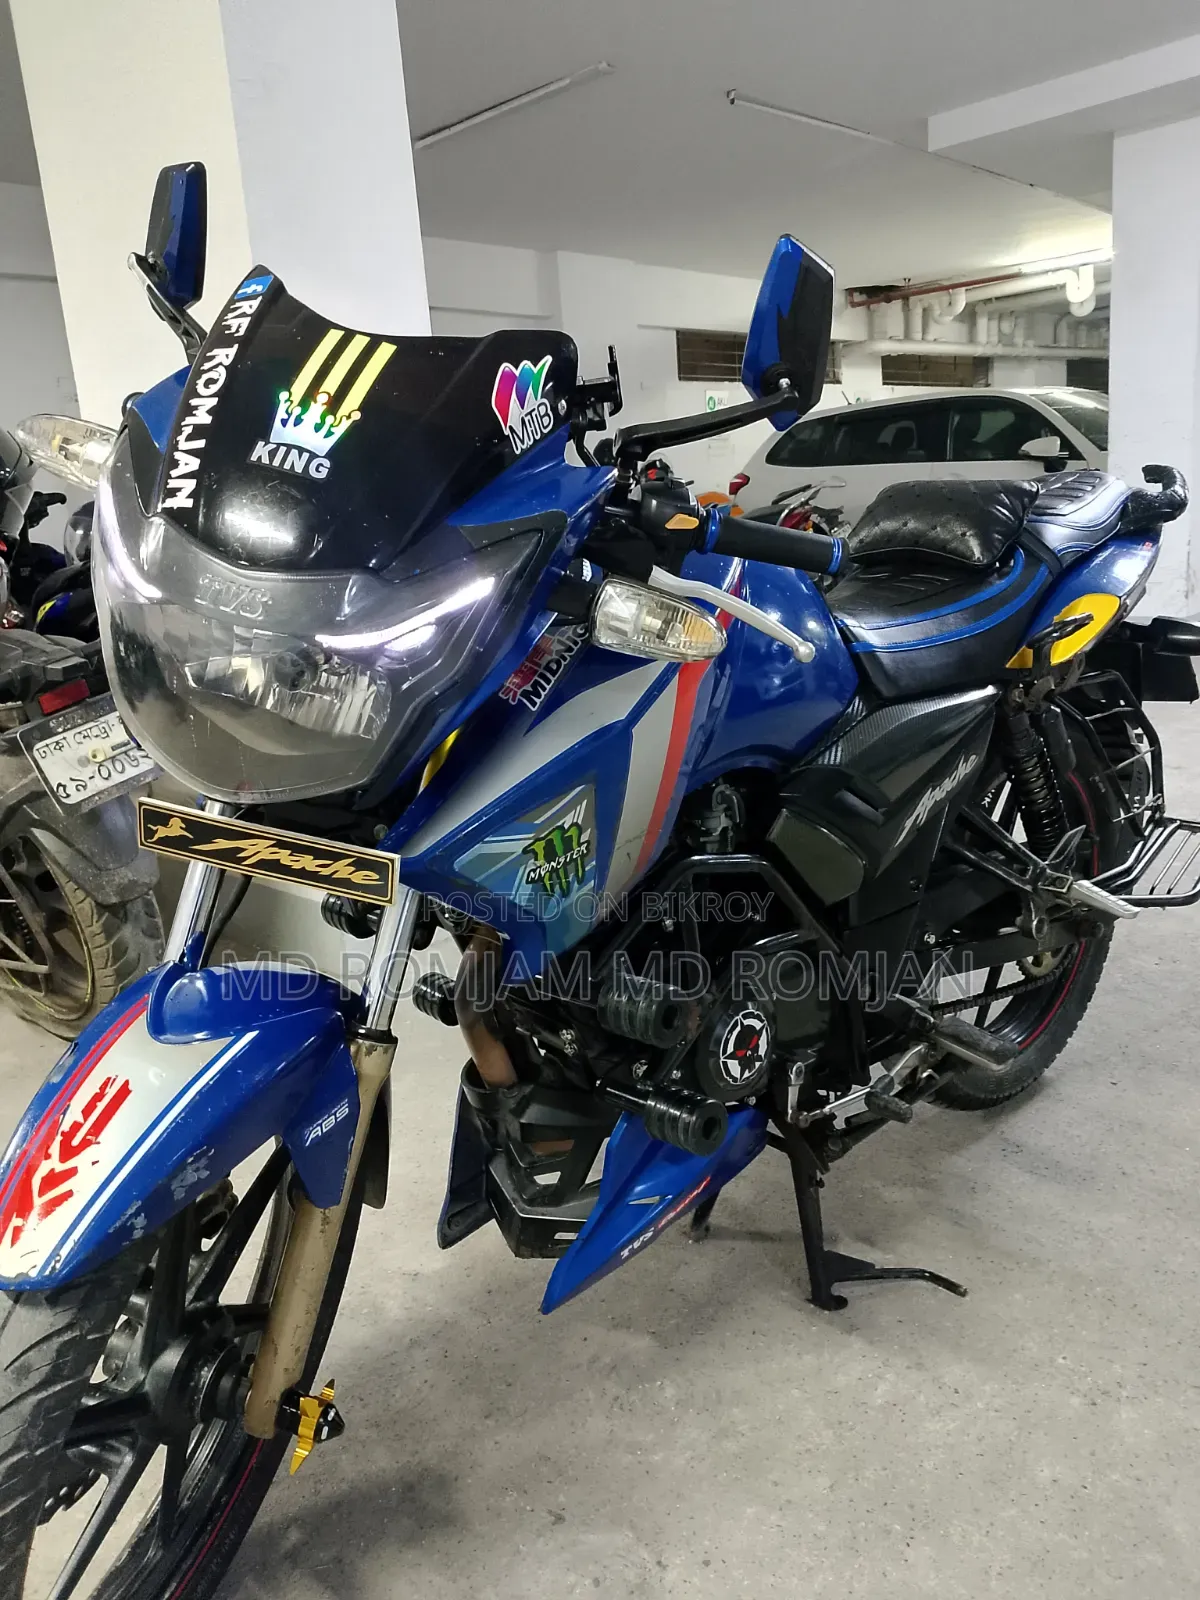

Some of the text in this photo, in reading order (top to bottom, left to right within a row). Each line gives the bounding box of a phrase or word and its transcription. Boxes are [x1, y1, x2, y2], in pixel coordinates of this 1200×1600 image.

[221, 295, 263, 337] RF
[161, 343, 239, 510] ROMJAN
[508, 400, 554, 453] MTB
[250, 440, 331, 479] KING
[194, 574, 273, 620] TVS
[35, 736, 72, 759] ঢাকা
[894, 754, 979, 847] Apache
[188, 838, 385, 885] Apache
[528, 842, 588, 881] MONSTER
[305, 1103, 349, 1146] ABS
